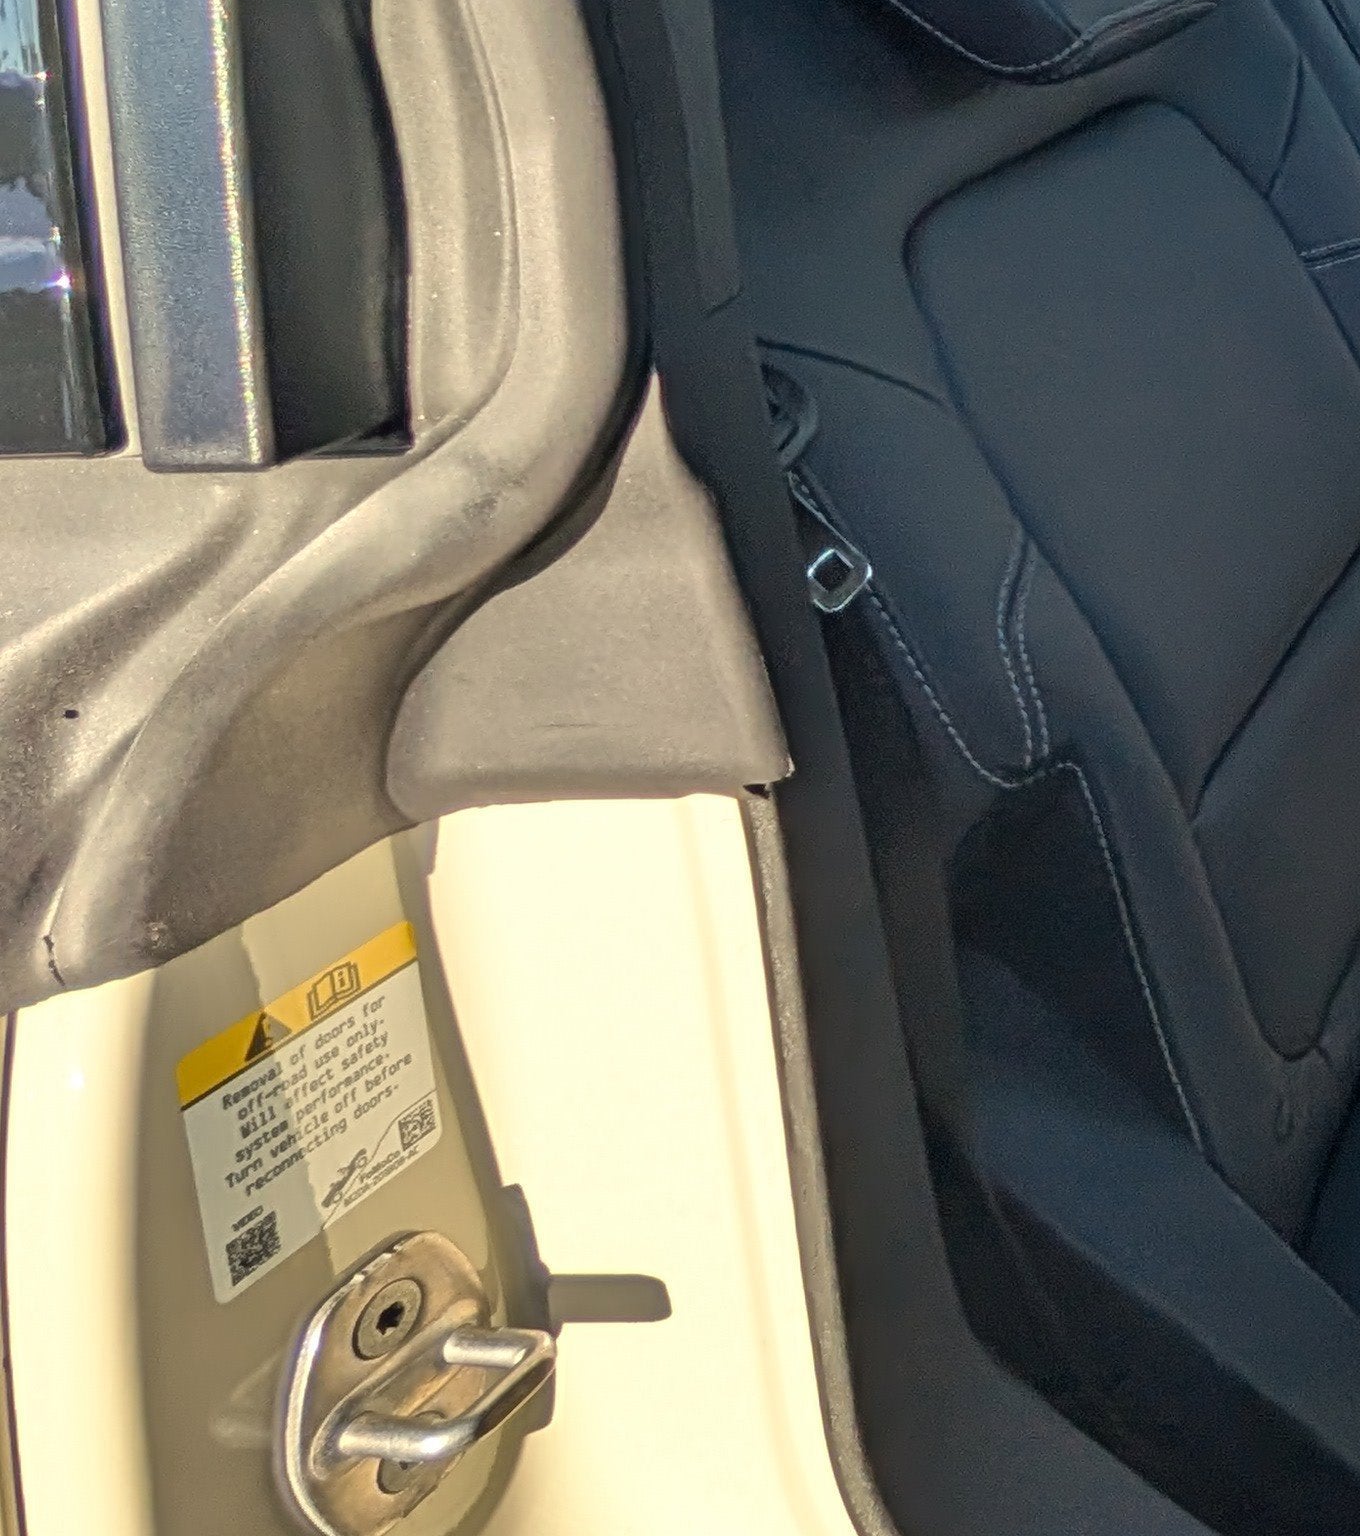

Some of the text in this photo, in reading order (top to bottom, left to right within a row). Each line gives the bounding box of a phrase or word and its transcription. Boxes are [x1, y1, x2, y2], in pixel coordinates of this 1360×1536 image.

[222, 995, 386, 1110] Removal of doors for
[238, 1067, 308, 1120] off-road
[314, 1046, 340, 1069] use
[341, 1031, 389, 1071] safety
[224, 1053, 413, 1188] Turn vehicle off before
[234, 1120, 289, 1164] system
[244, 1117, 348, 1197] reconnecting
[353, 1084, 400, 1120] doors.
